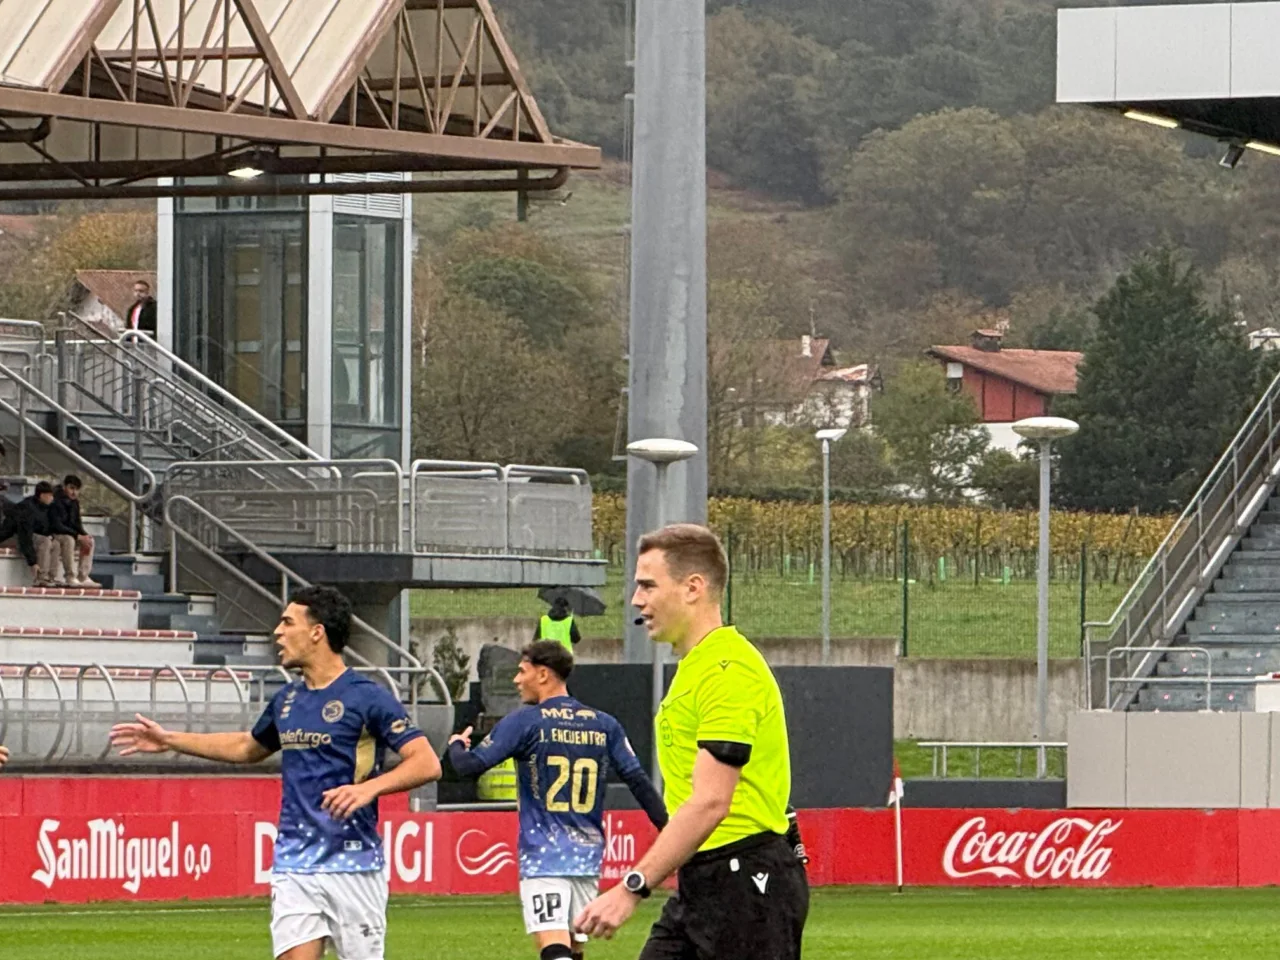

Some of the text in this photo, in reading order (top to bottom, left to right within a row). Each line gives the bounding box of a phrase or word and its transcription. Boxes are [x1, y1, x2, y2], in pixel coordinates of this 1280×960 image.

[280, 728, 331, 747] elefurgo
[546, 755, 598, 814] 20
[184, 843, 211, 881] 0,0
[601, 813, 635, 862] kin
[942, 816, 1124, 880] Coca-Cola
